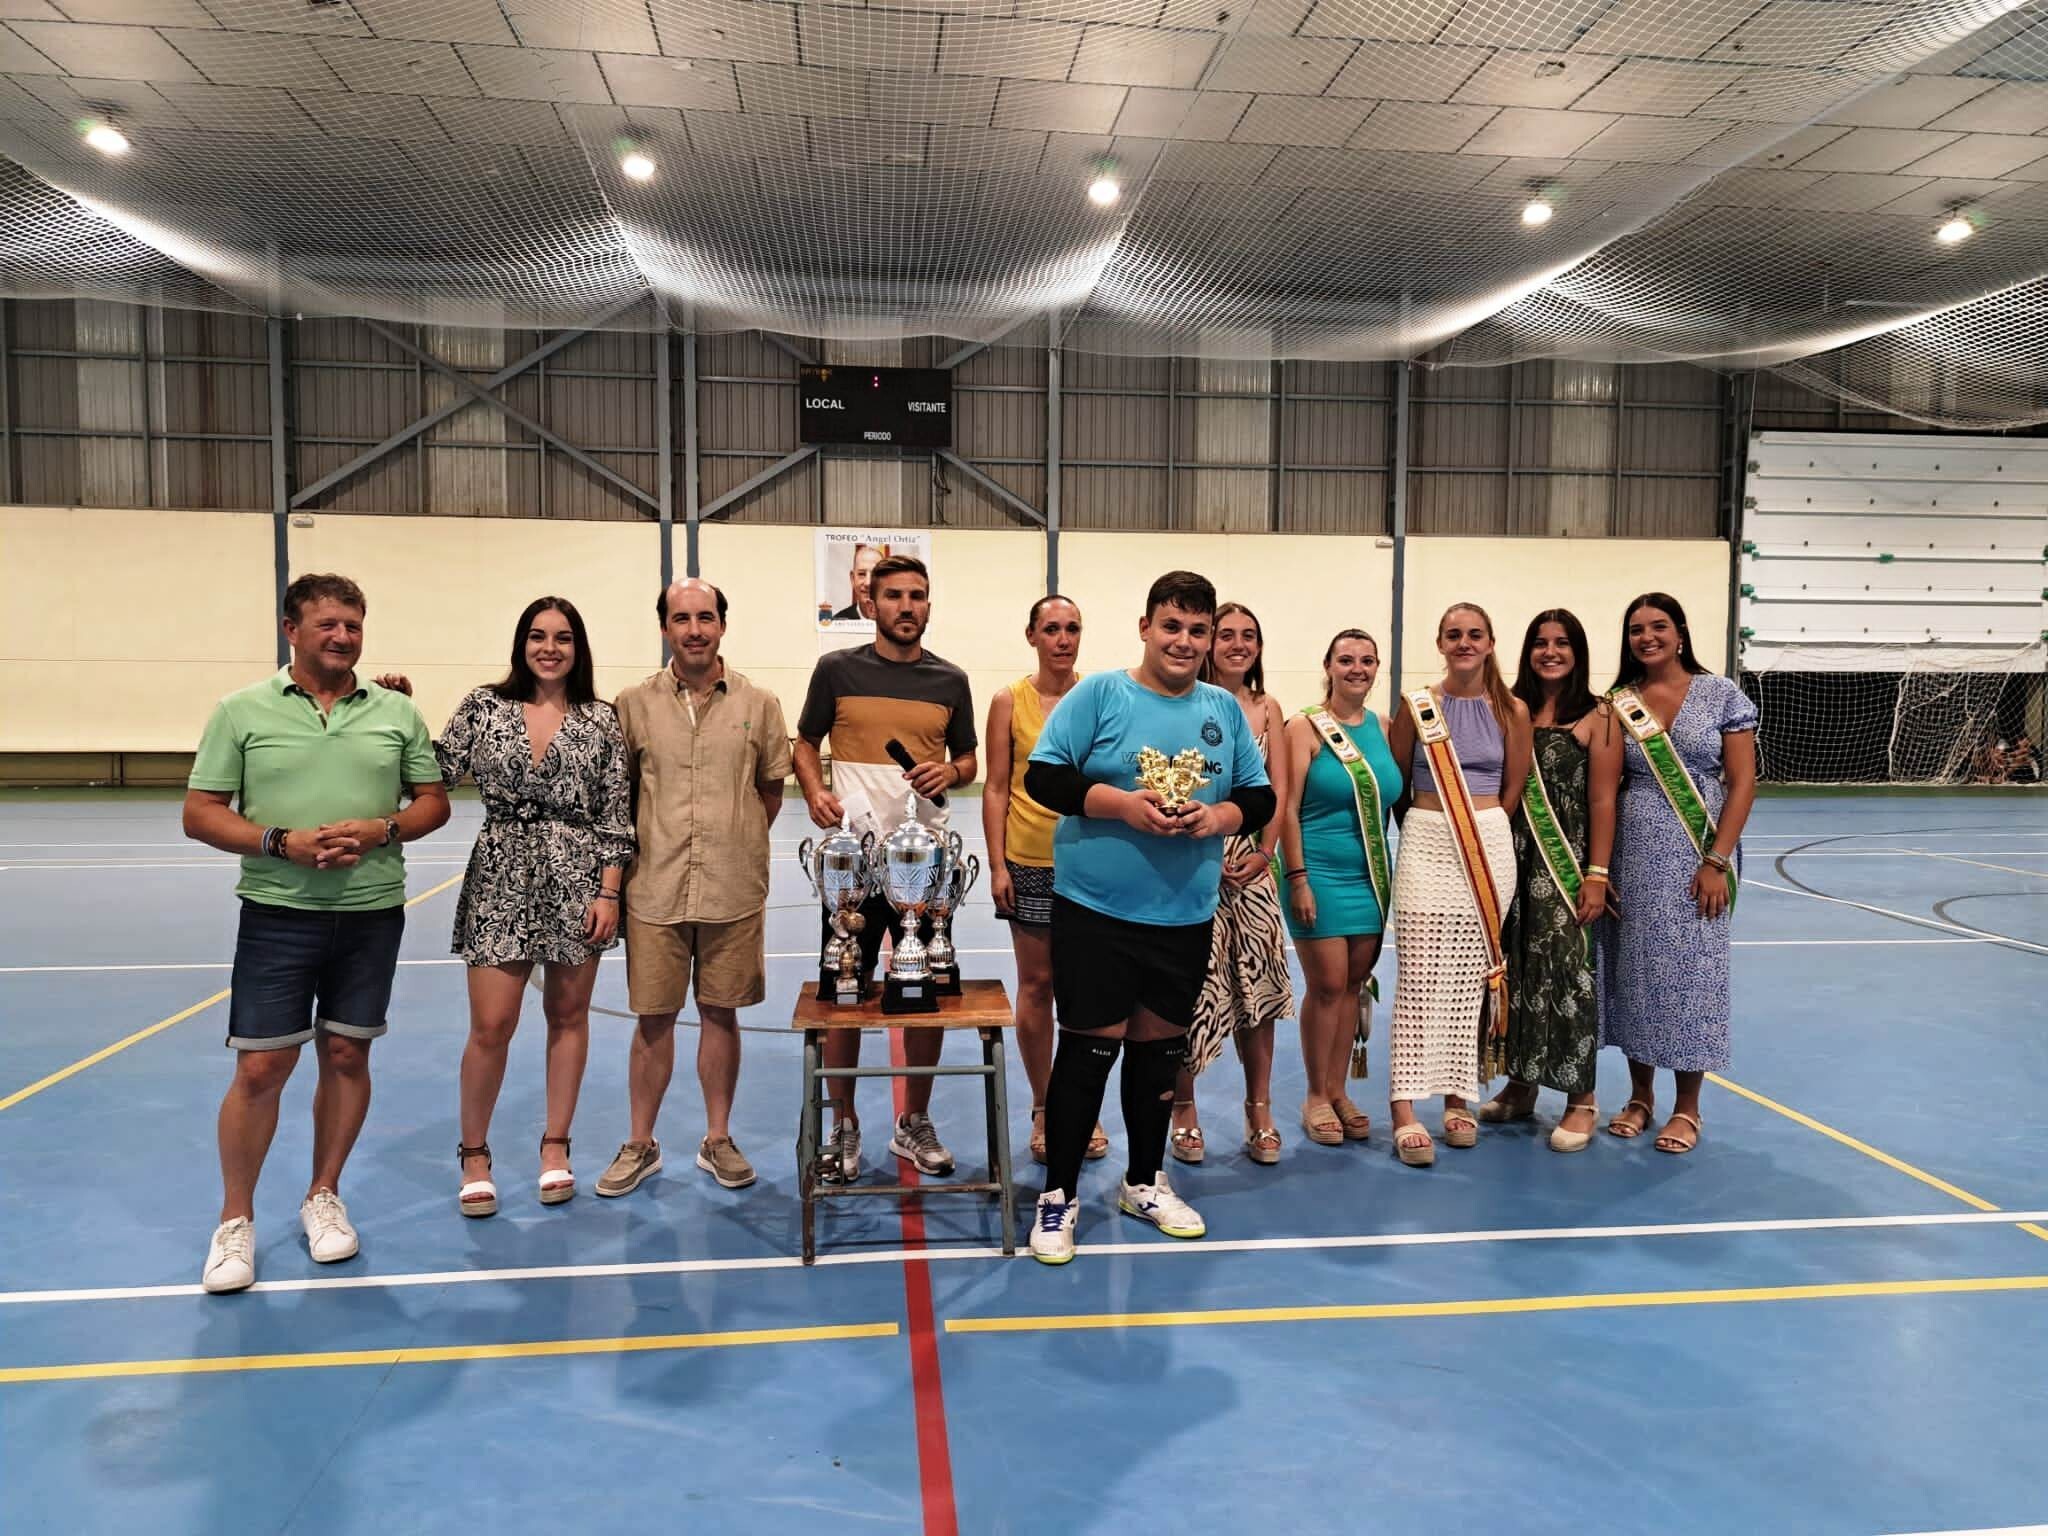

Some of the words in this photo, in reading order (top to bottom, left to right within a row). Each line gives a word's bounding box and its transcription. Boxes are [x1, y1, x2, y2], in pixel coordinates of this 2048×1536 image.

[805, 398, 845, 409] LOCAL
[908, 402, 946, 412] VISITANTE
[864, 431, 891, 440] PERIODO
